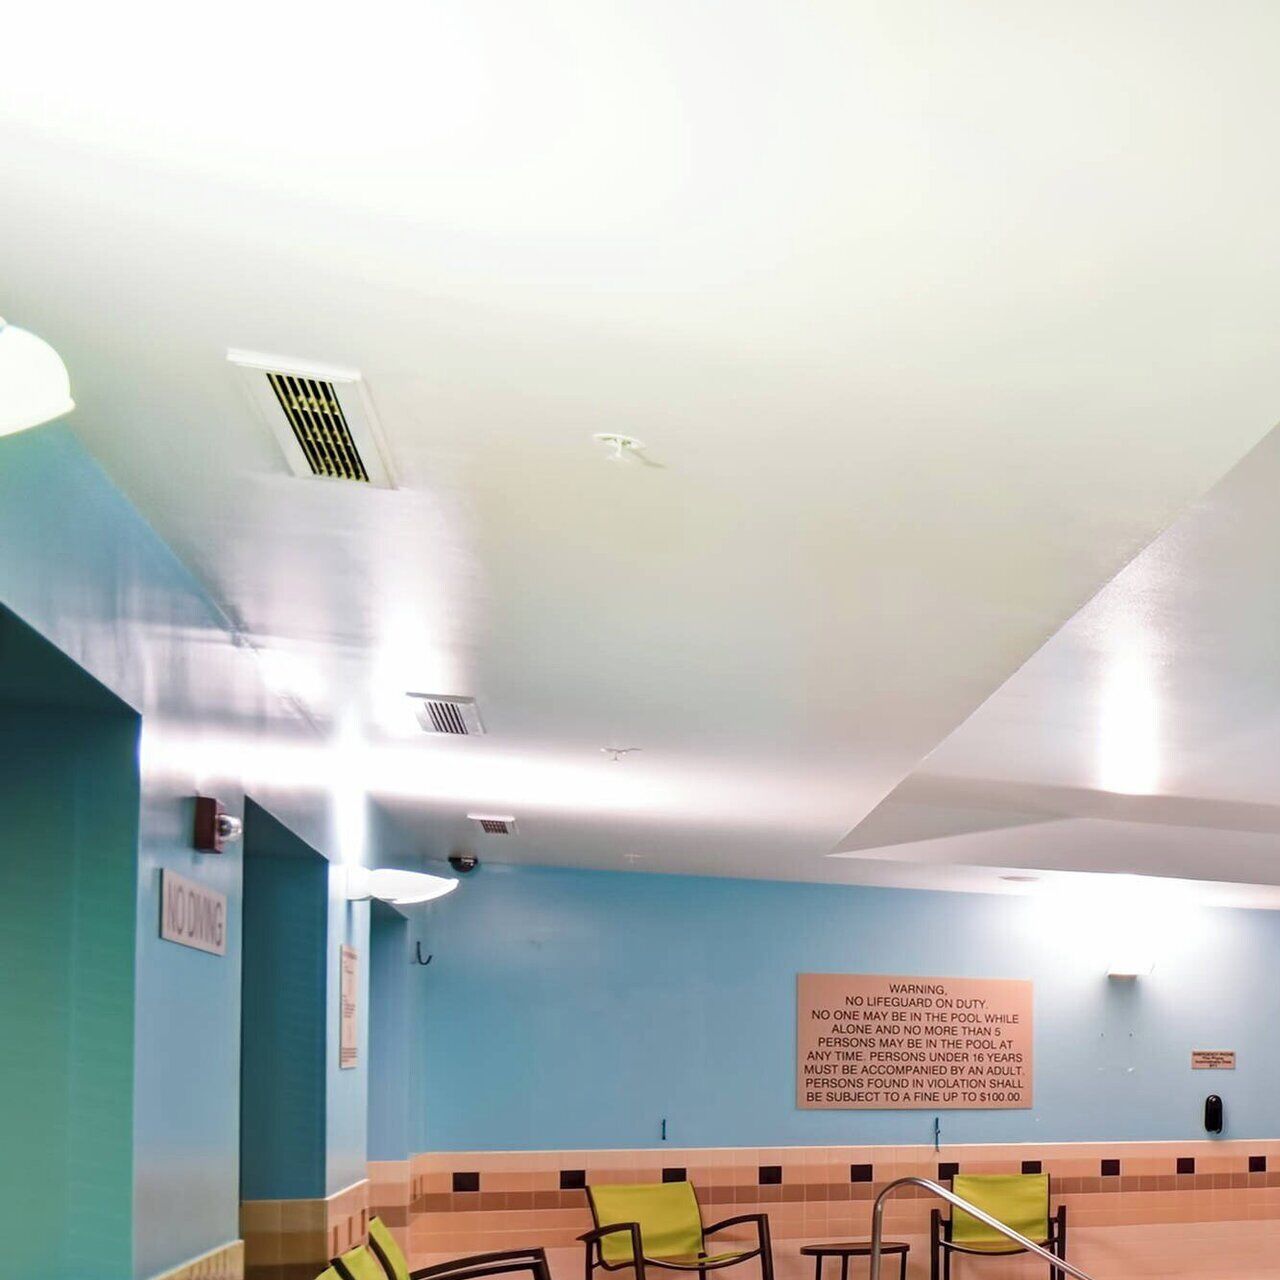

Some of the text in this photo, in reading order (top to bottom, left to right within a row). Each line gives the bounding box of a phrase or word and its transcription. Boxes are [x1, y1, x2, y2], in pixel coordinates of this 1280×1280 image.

[167, 880, 184, 935] NO
[846, 997, 863, 1006] NO
[867, 998, 932, 1007] LIFEGUARD
[936, 999, 952, 1008] ON
[812, 1010, 1018, 1024] NO ONE MAY BE IN THE POOL WHILE
[832, 1024, 1000, 1036] ALONE AND NO MORE THAN 5
[818, 1038, 1013, 1049] PERSONS MAY BE IN THE POOL AT
[807, 1052, 831, 1061] ANY
[870, 1052, 926, 1062] PERSONS
[929, 1053, 968, 1062] UNDER
[973, 1053, 984, 1062] 16
[987, 1053, 1022, 1063] YEARS
[804, 1065, 838, 1074] MUST
[842, 1065, 857, 1074] BE
[861, 1065, 947, 1075] ACCOMPANIED
[950, 1066, 965, 1075] BY
[968, 1066, 984, 1075] AN
[806, 1078, 1023, 1089] PERSONS FOUND IN VIOLATION SHALL
[807, 1092, 822, 1102] BE
[826, 1092, 880, 1102] SUBJECT
[884, 1092, 900, 1101] TO
[903, 1092, 910, 1101] A
[914, 1092, 939, 1101] FINE
[943, 1092, 958, 1101] UP
[961, 1092, 976, 1101] TO
